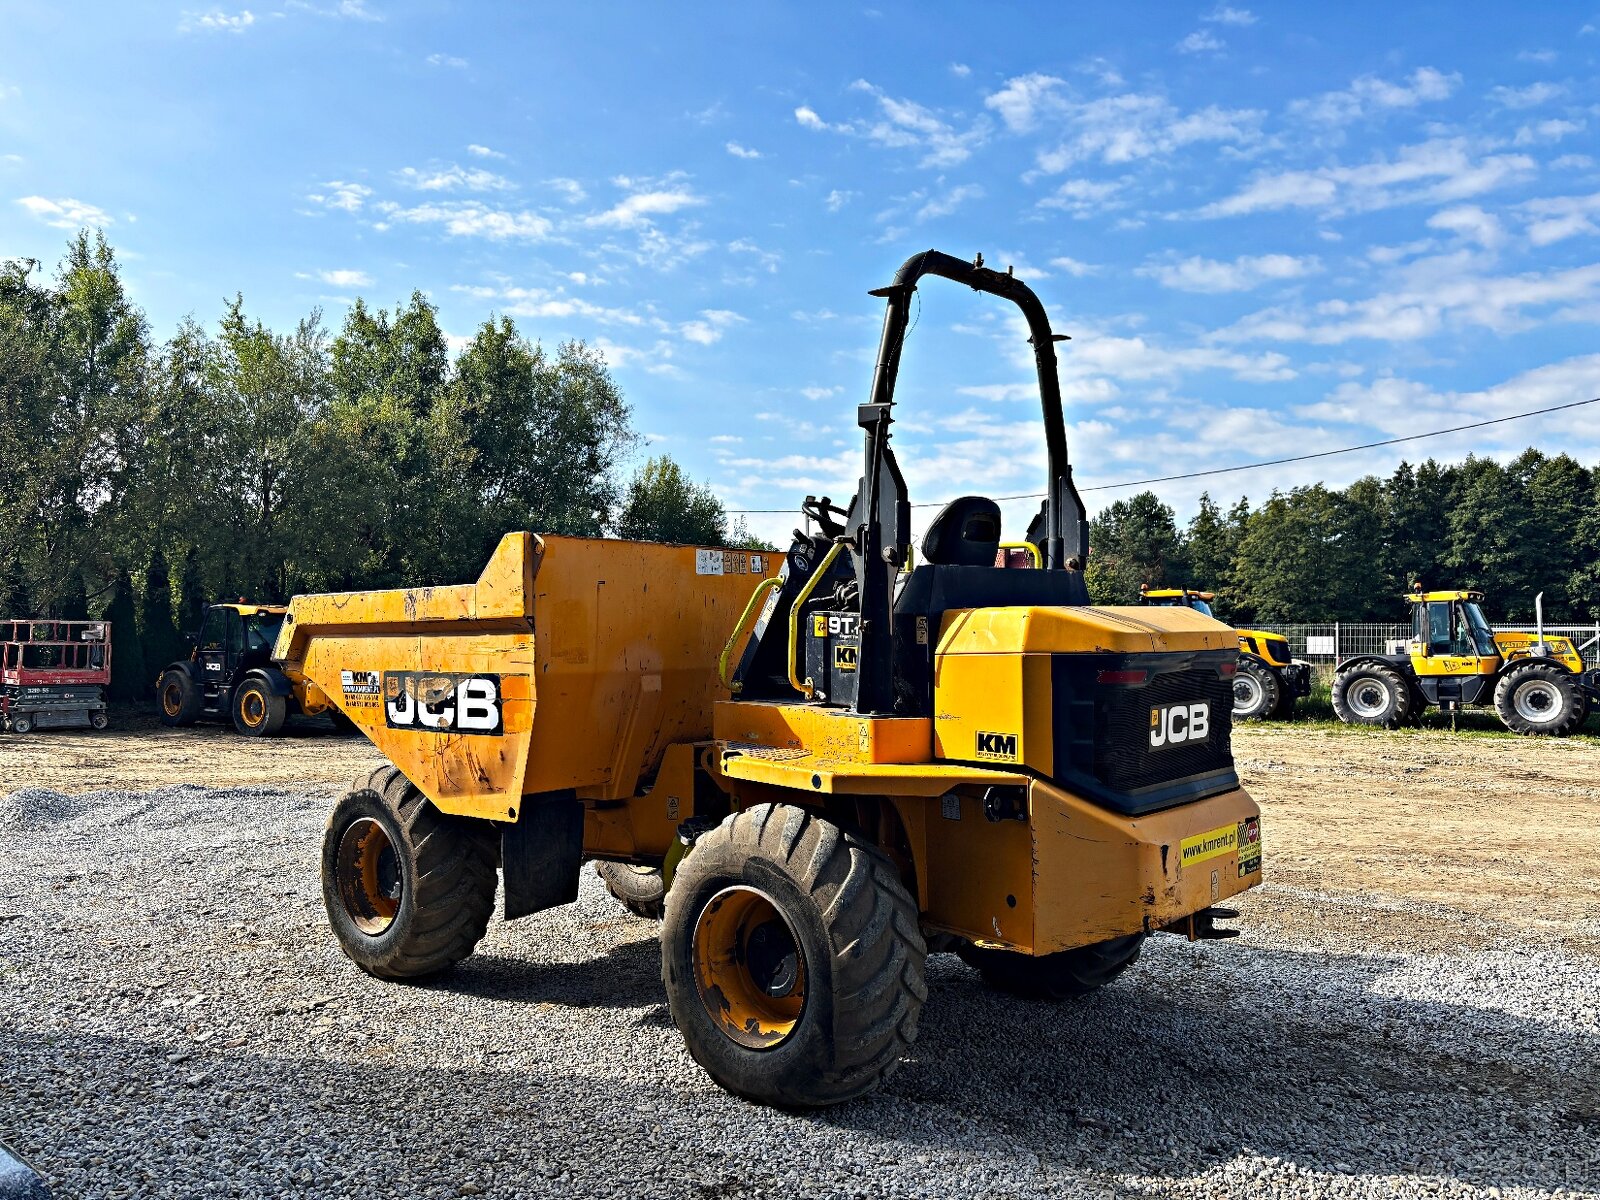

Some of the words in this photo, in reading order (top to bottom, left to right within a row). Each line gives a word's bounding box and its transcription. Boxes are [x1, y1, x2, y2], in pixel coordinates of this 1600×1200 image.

[206, 663, 220, 671] JCB
[387, 677, 500, 729] JCB
[1150, 703, 1209, 747] JCB
[978, 733, 1016, 756] KM
[1183, 829, 1236, 859] www.kmrent.pl
